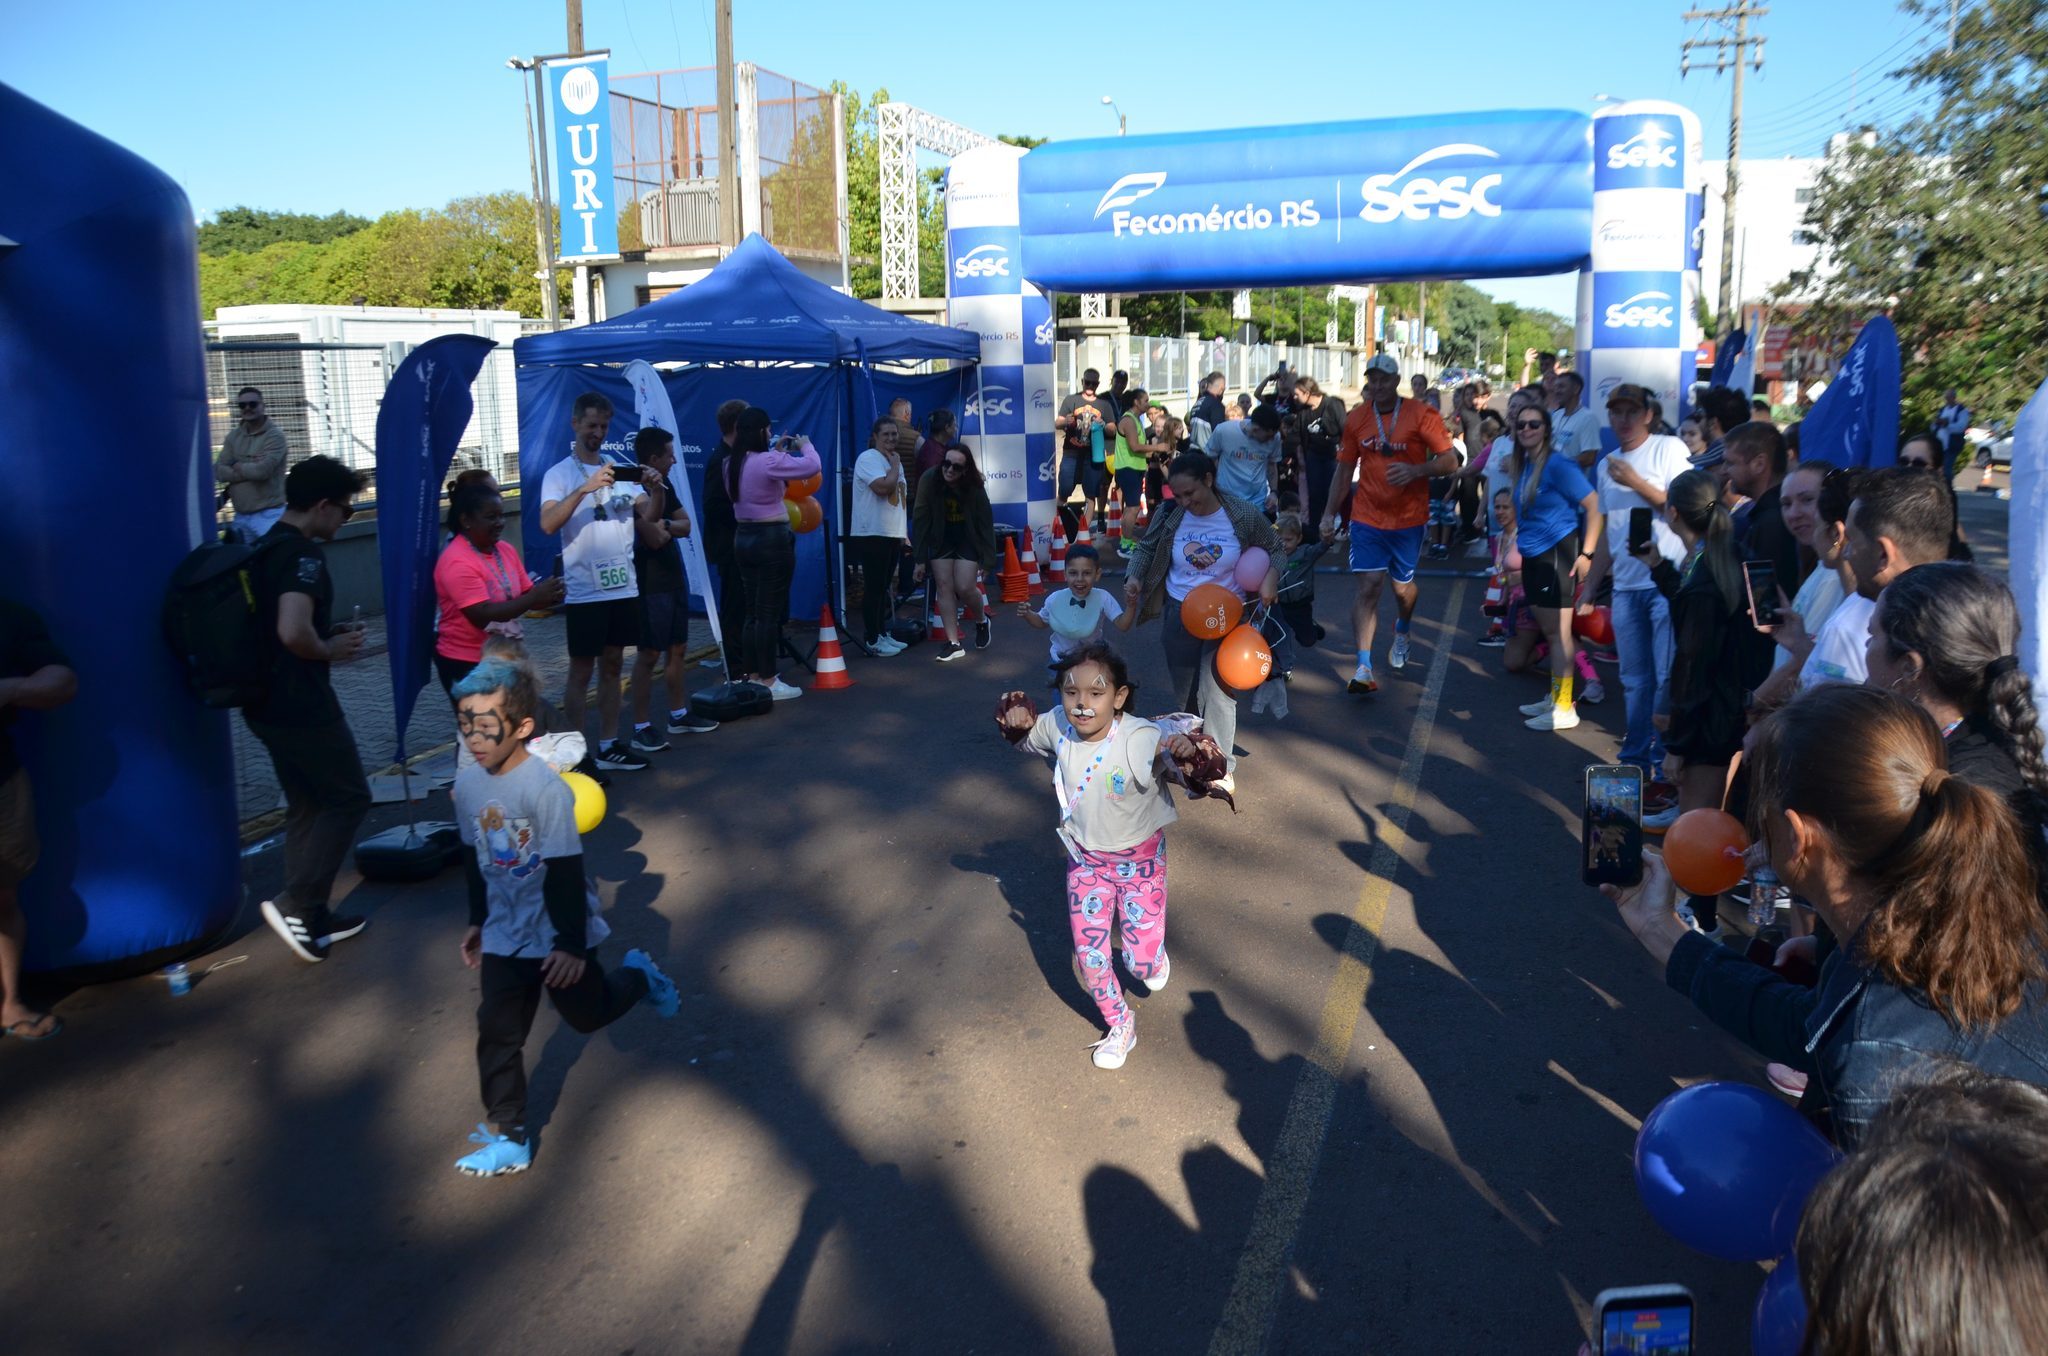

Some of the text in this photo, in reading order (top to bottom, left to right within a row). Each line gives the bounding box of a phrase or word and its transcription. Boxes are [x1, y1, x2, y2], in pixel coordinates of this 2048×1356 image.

[566, 123, 603, 253] URI
[1112, 199, 1320, 237] Fecomércio RS
[1010, 470, 1023, 479] RS
[600, 566, 627, 587] 566
